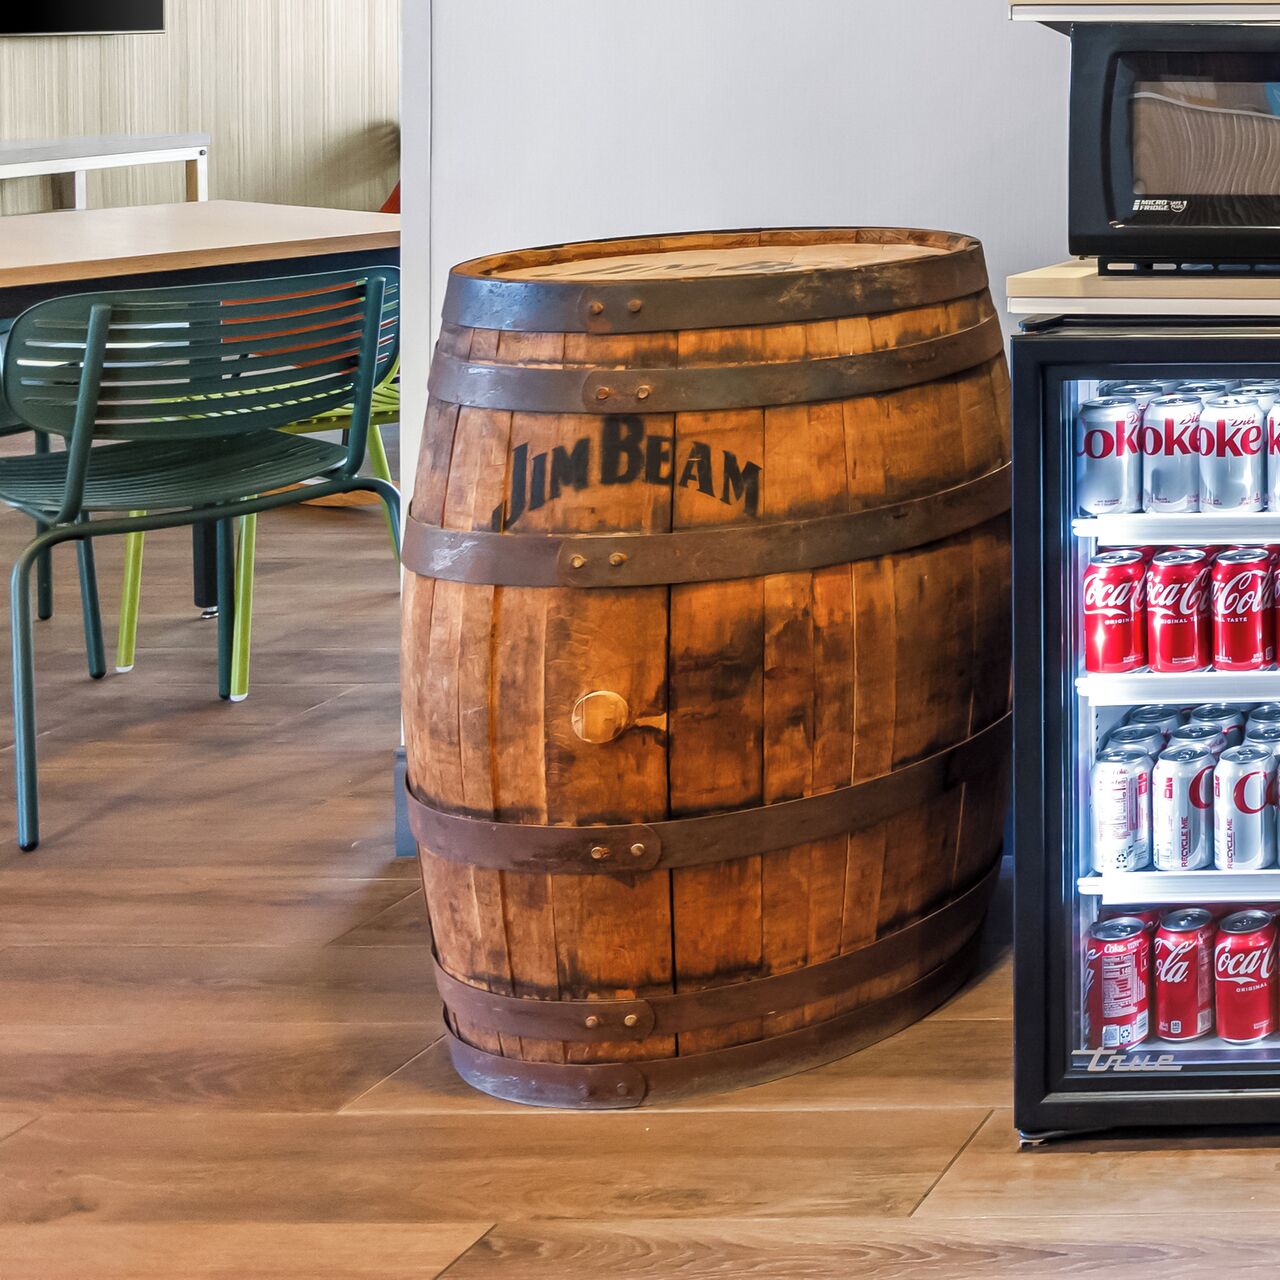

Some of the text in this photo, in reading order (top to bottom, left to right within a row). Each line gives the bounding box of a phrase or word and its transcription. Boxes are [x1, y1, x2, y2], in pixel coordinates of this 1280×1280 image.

[492, 414, 763, 533] JIM BEAM
[1181, 816, 1189, 868] RECYCLE ME
[1226, 818, 1234, 869] RECYCLE ME
[1236, 982, 1268, 993] ORIGINAL
